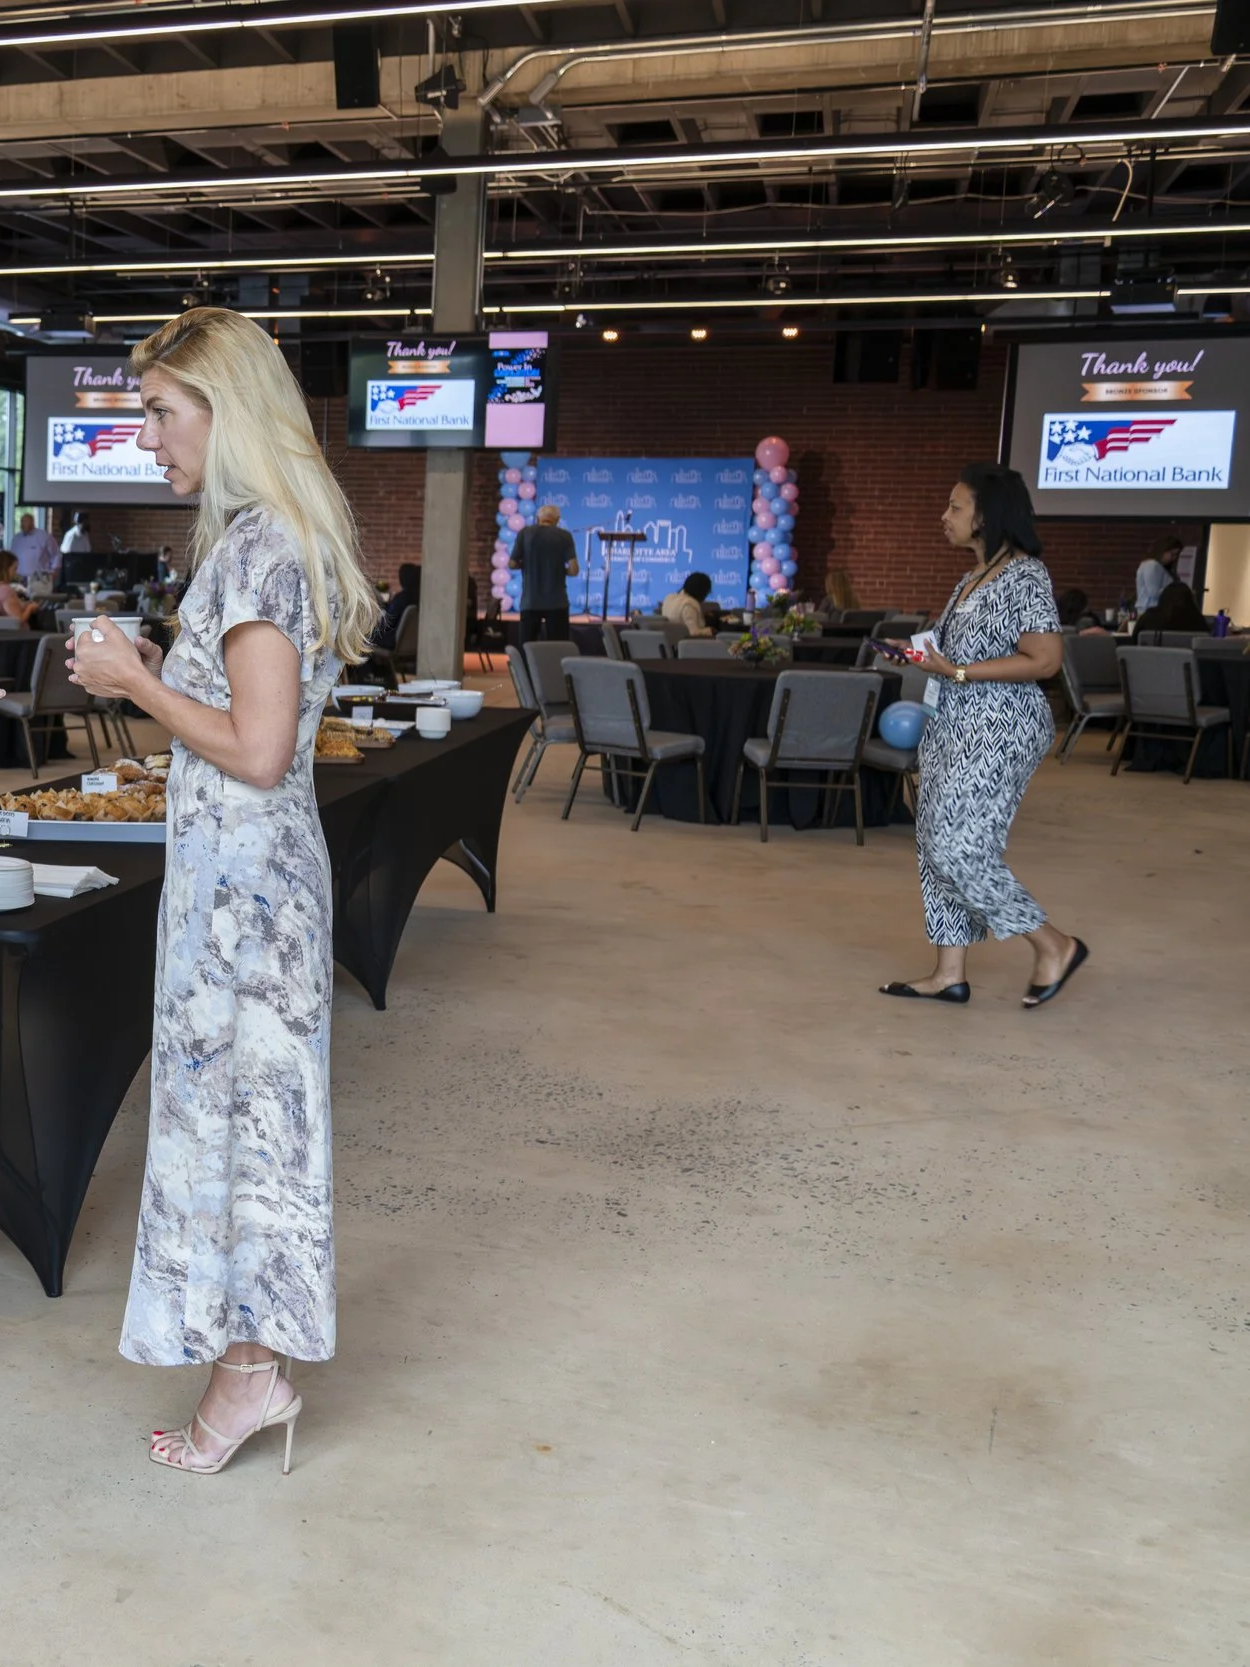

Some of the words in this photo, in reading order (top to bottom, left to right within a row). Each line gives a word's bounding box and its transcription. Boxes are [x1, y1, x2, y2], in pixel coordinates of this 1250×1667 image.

[386, 341, 426, 358] Thank
[428, 340, 456, 359] you!
[1081, 352, 1149, 376] Thank
[1152, 350, 1204, 380] you!
[73, 367, 124, 386] Thank
[370, 414, 390, 425] First
[394, 414, 438, 426] National
[442, 415, 470, 426] Bank
[52, 462, 78, 476] First
[82, 462, 141, 476] National
[145, 463, 166, 476] Ba
[1044, 466, 1080, 482] First
[1086, 466, 1166, 483] National
[1172, 466, 1222, 482] Bank
[605, 548, 654, 556] HAROTTE
